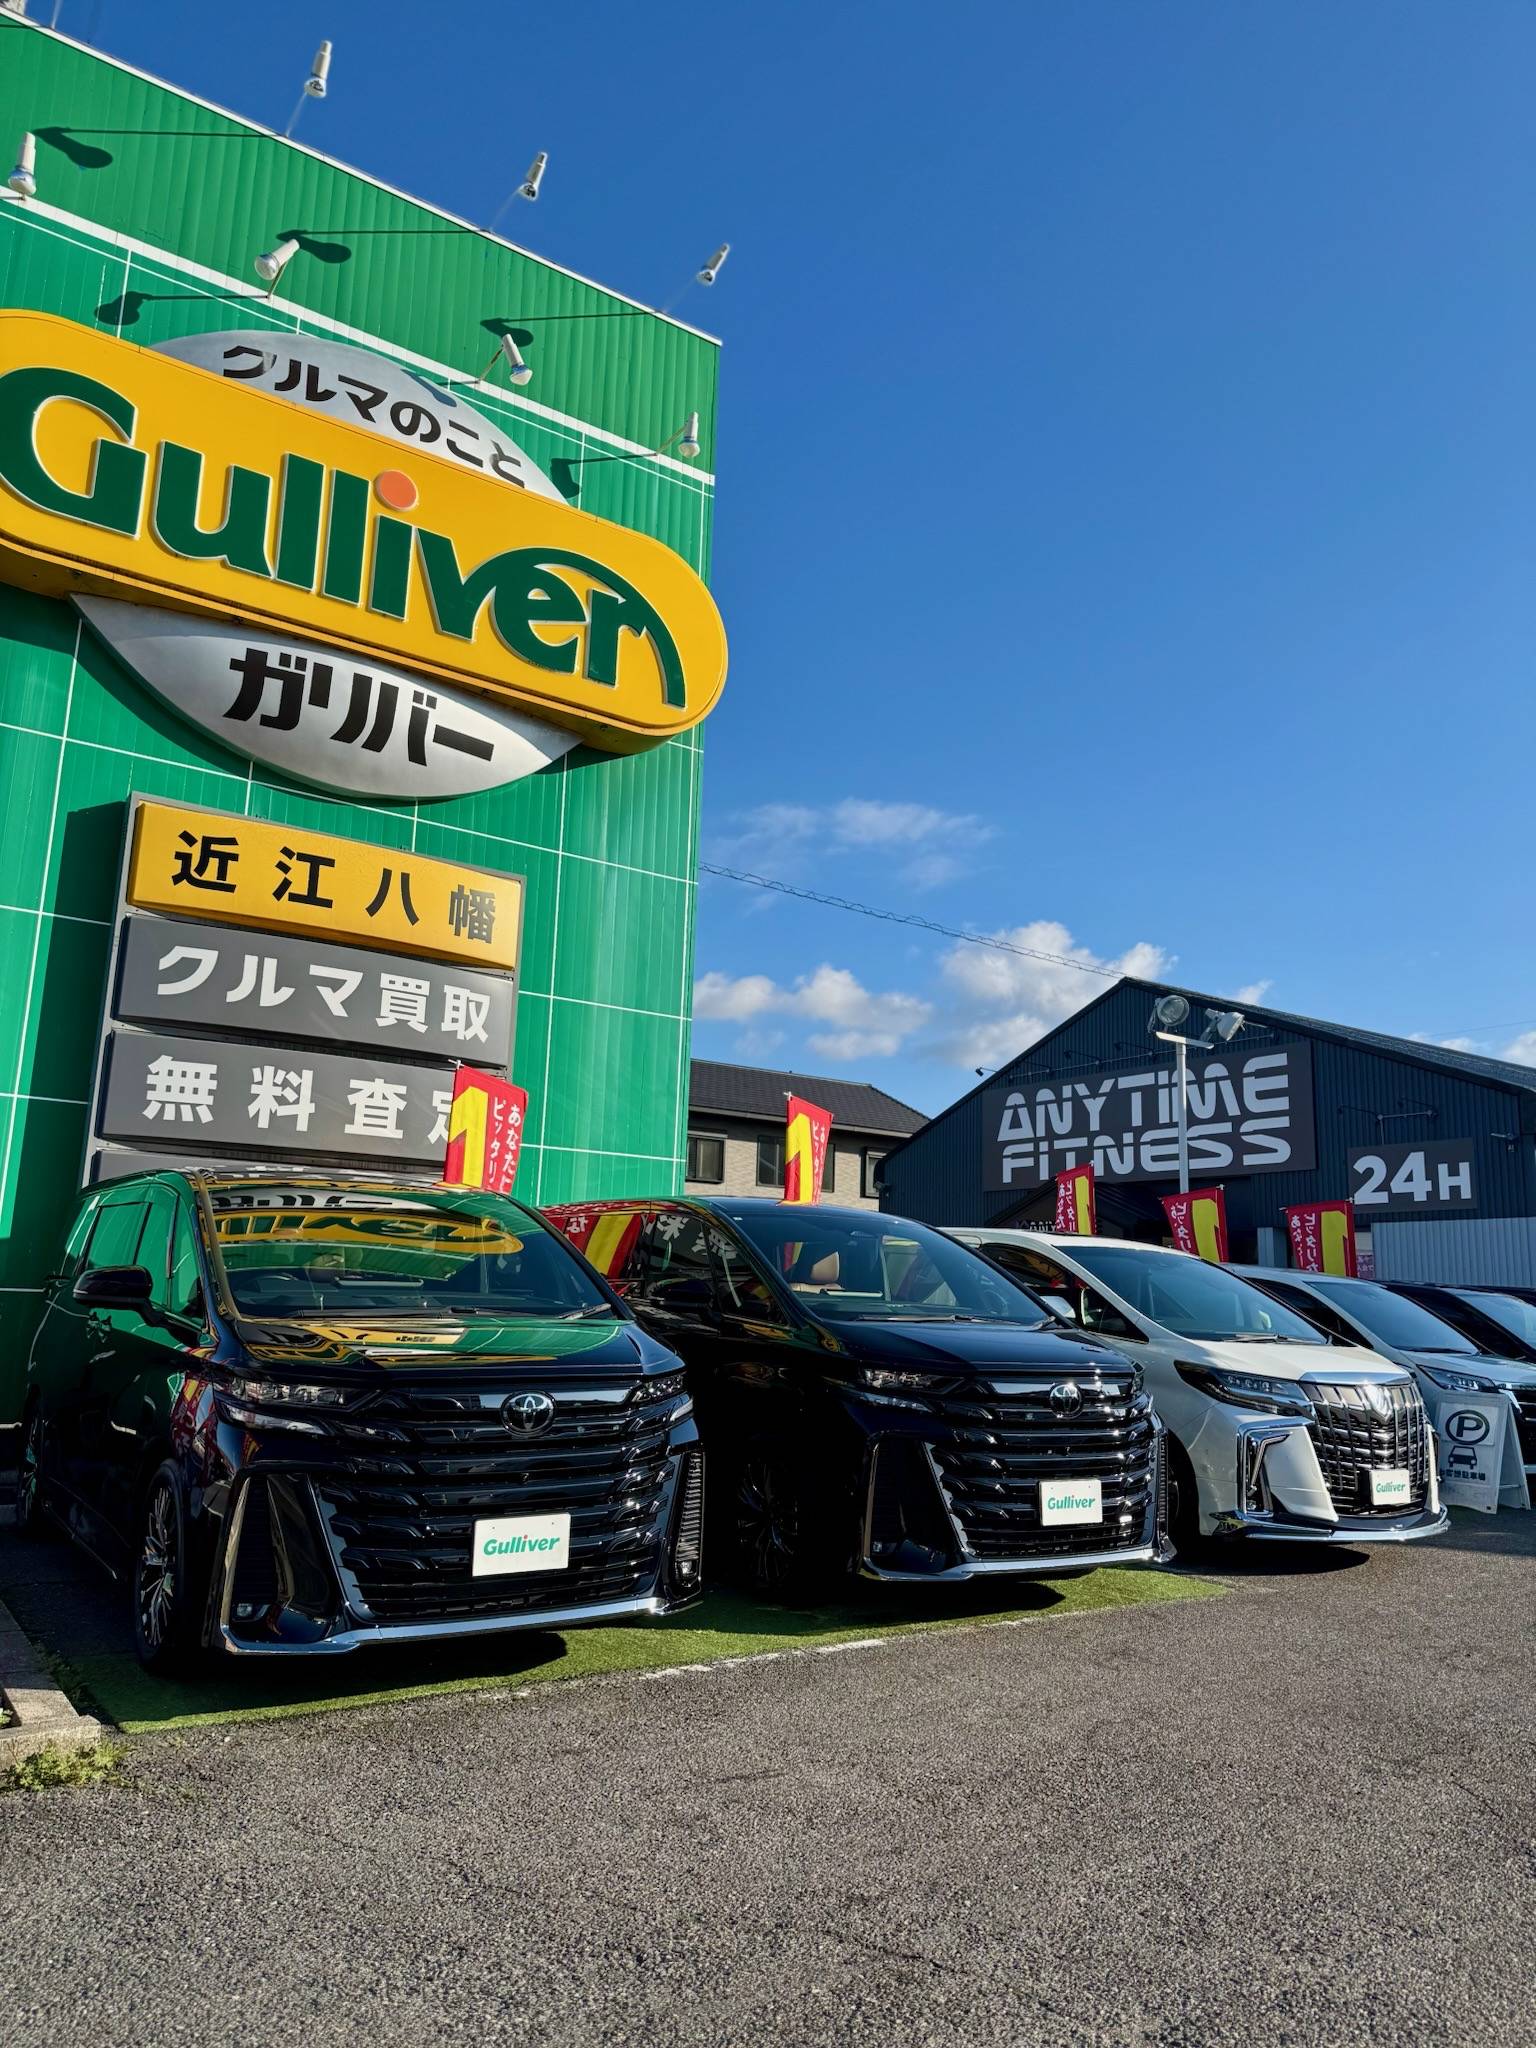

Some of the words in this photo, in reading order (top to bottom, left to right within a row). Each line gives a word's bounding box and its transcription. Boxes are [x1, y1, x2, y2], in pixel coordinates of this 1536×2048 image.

[223, 344, 526, 488] クルマのこと
[0, 366, 687, 709] Gulliver
[223, 647, 495, 767] ガリバー
[171, 829, 496, 944] 近江八幡
[156, 944, 492, 1044] クルマ買取
[997, 1052, 1290, 1142] ANYTIME
[1002, 1115, 1292, 1184] FITNESS
[1353, 1151, 1472, 1205] 24H
[483, 1534, 561, 1556] Gulliver
[1047, 1495, 1096, 1510] Gulliver
